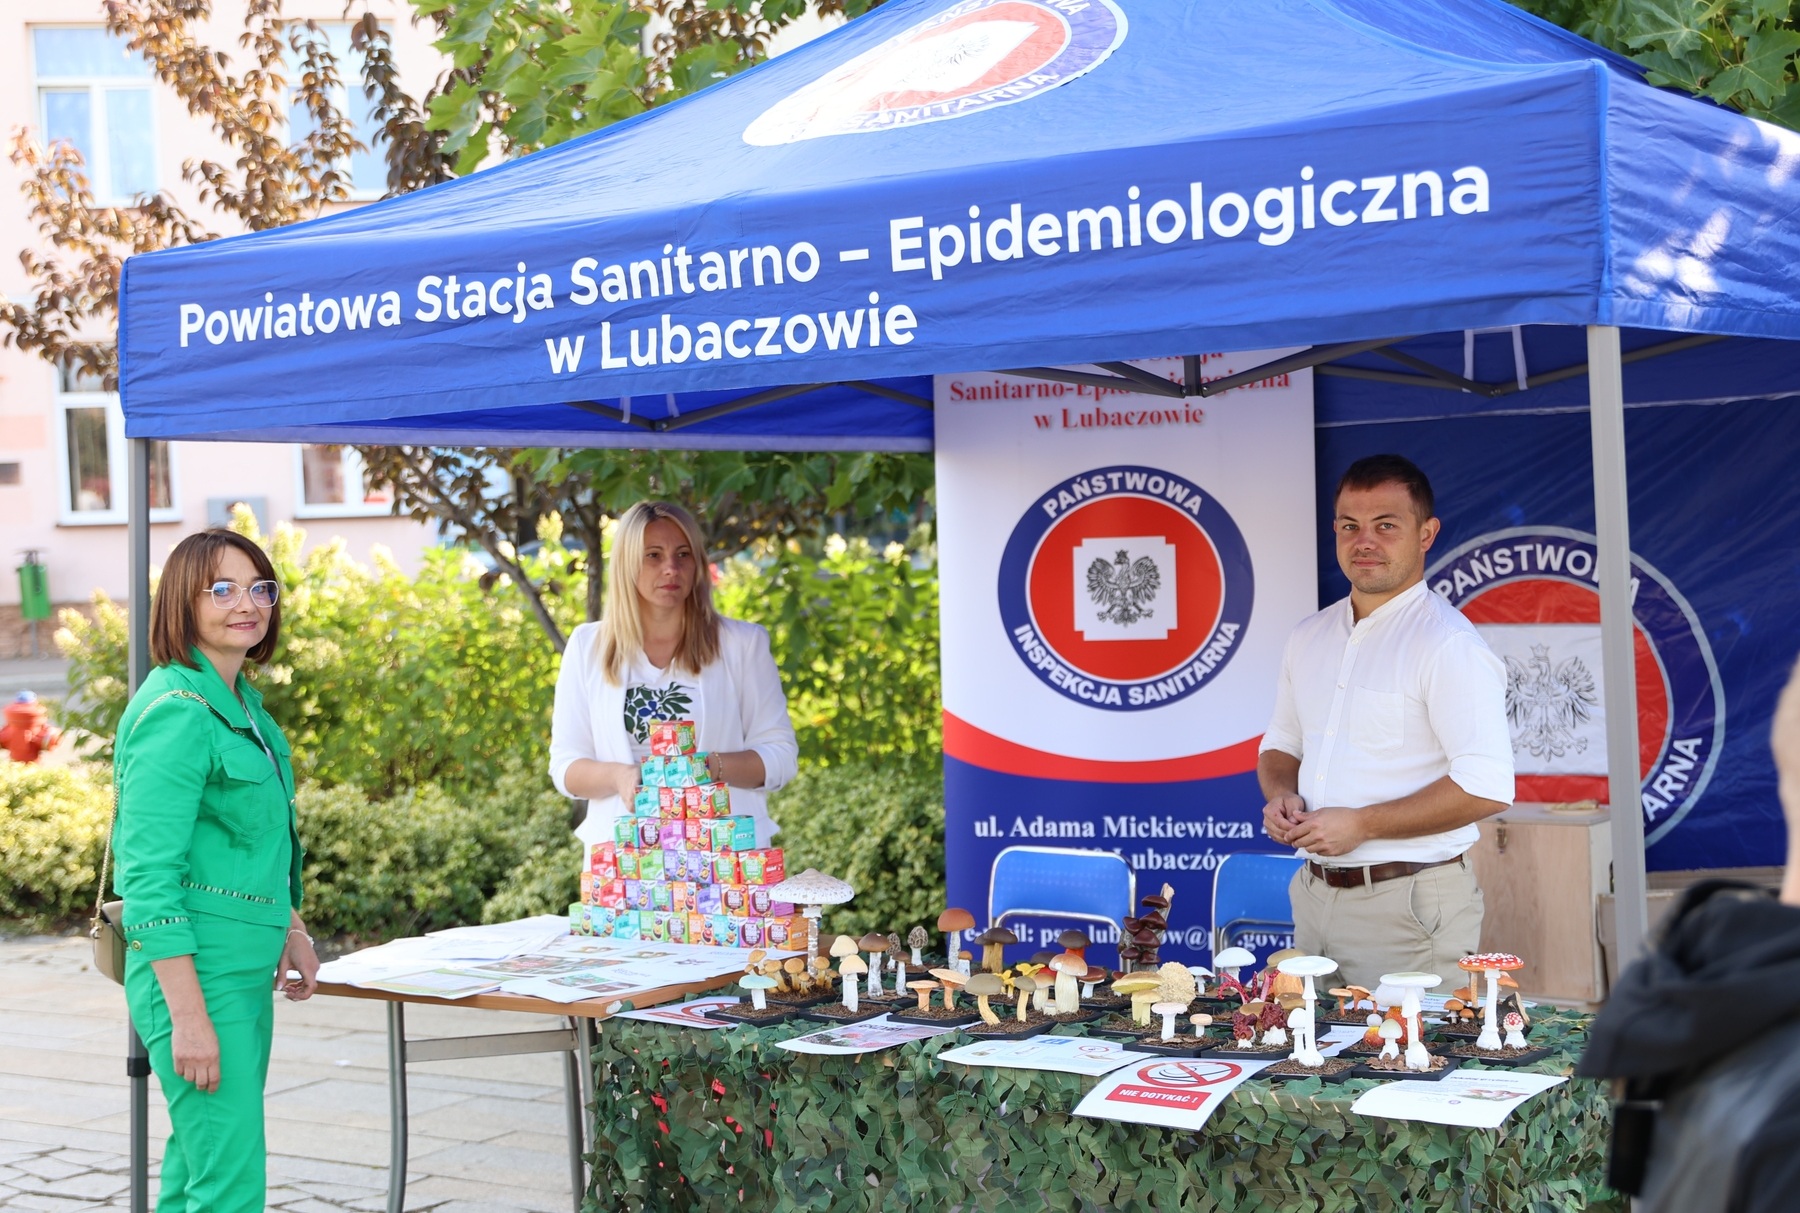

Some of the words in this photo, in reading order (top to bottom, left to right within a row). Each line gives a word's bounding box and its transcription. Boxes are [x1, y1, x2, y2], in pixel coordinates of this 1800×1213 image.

[180, 291, 400, 347] Powiatowa
[415, 262, 554, 323] Stacja
[570, 242, 819, 305] Sanitarno
[889, 166, 1490, 280] Epidemiologiczna
[545, 336, 585, 373] w
[601, 292, 918, 369] Lubaczowie
[1033, 414, 1054, 430] w
[1061, 403, 1204, 430] Lubaczowie
[1042, 471, 1203, 520] PAŃSTWOWA
[1432, 543, 1640, 607] PAŃSTWO
[1013, 623, 1122, 706] INSPEKCJA
[1128, 621, 1240, 706] SANITARNA
[974, 815, 1004, 838] ul.
[1009, 815, 1096, 838] Adama
[1103, 815, 1254, 839] Mickiewicza
[1118, 1089, 1140, 1097] NIE
[1139, 1091, 1191, 1103] DOTYKAĆ
